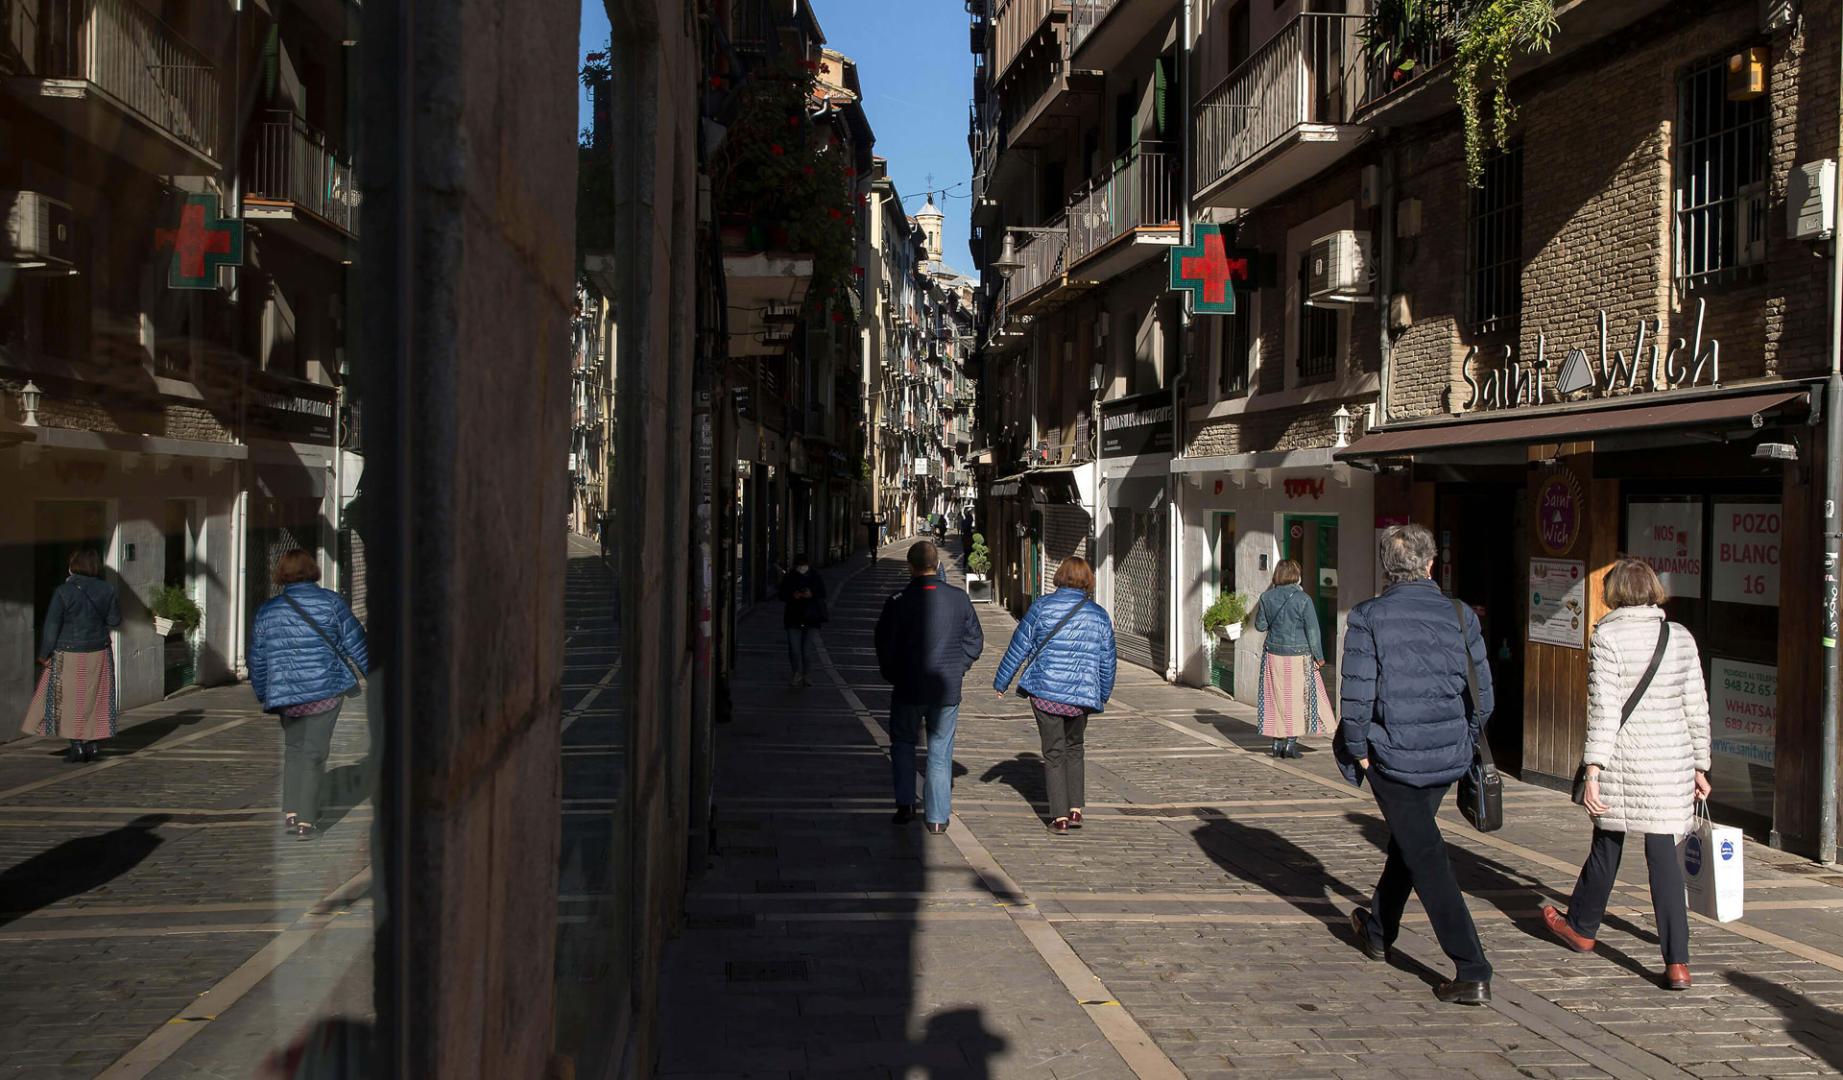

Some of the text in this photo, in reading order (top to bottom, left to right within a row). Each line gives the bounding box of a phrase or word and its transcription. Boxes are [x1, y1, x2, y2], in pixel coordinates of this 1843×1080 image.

[1463, 297, 1720, 410] Saint Wich
[1544, 486, 1572, 508] Saint
[1543, 518, 1569, 544] Wich
[1654, 526, 1674, 541] NOS
[1732, 513, 1780, 534] POZO
[1720, 543, 1780, 564] BLANC
[1744, 575, 1765, 594] 16
[1724, 678, 1741, 691] 948
[1744, 682, 1755, 694] 22
[1758, 684, 1771, 697] 65
